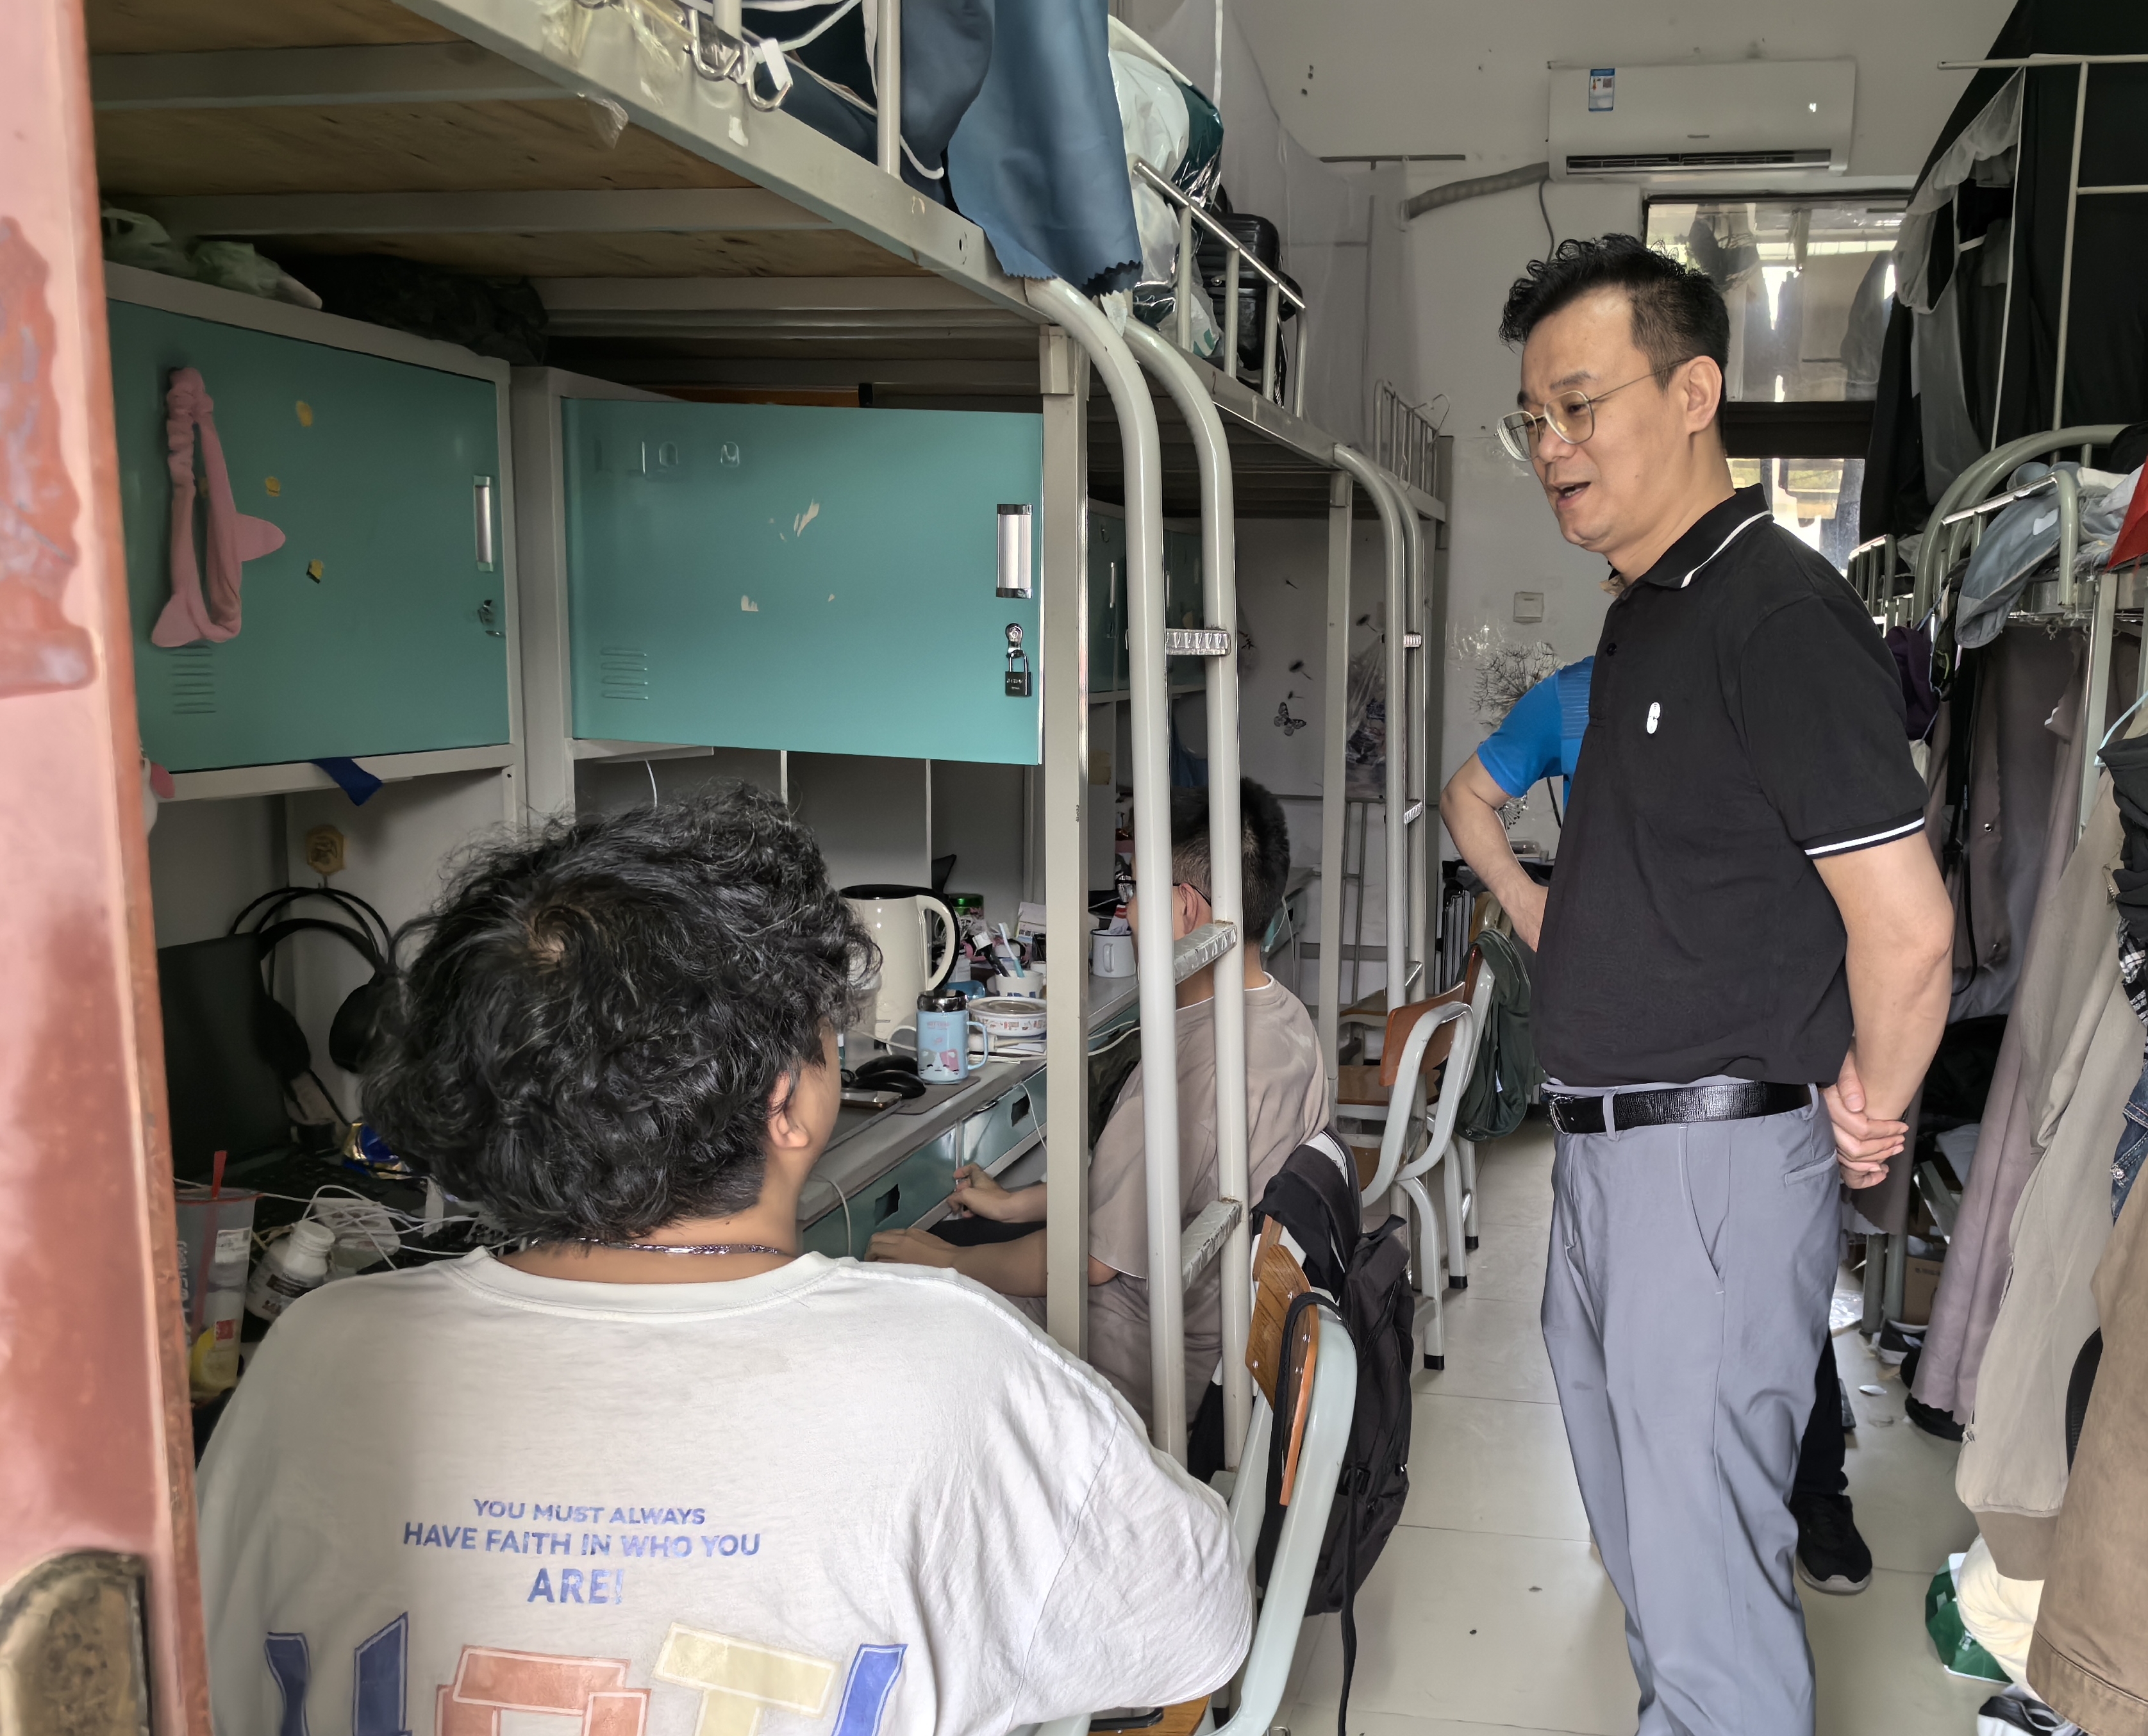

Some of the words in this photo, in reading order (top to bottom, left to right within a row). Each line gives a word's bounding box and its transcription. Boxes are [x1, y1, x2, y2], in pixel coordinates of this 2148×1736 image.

[473, 1499, 525, 1519] YOU
[533, 1504, 604, 1524] MUST
[609, 1507, 706, 1525] ALWAYS
[403, 1522, 478, 1550] HAVE
[485, 1529, 571, 1555] FAITH
[581, 1533, 612, 1556] IN
[620, 1535, 692, 1558] WHO
[701, 1533, 761, 1557] YOU
[527, 1567, 624, 1605] ARE!
